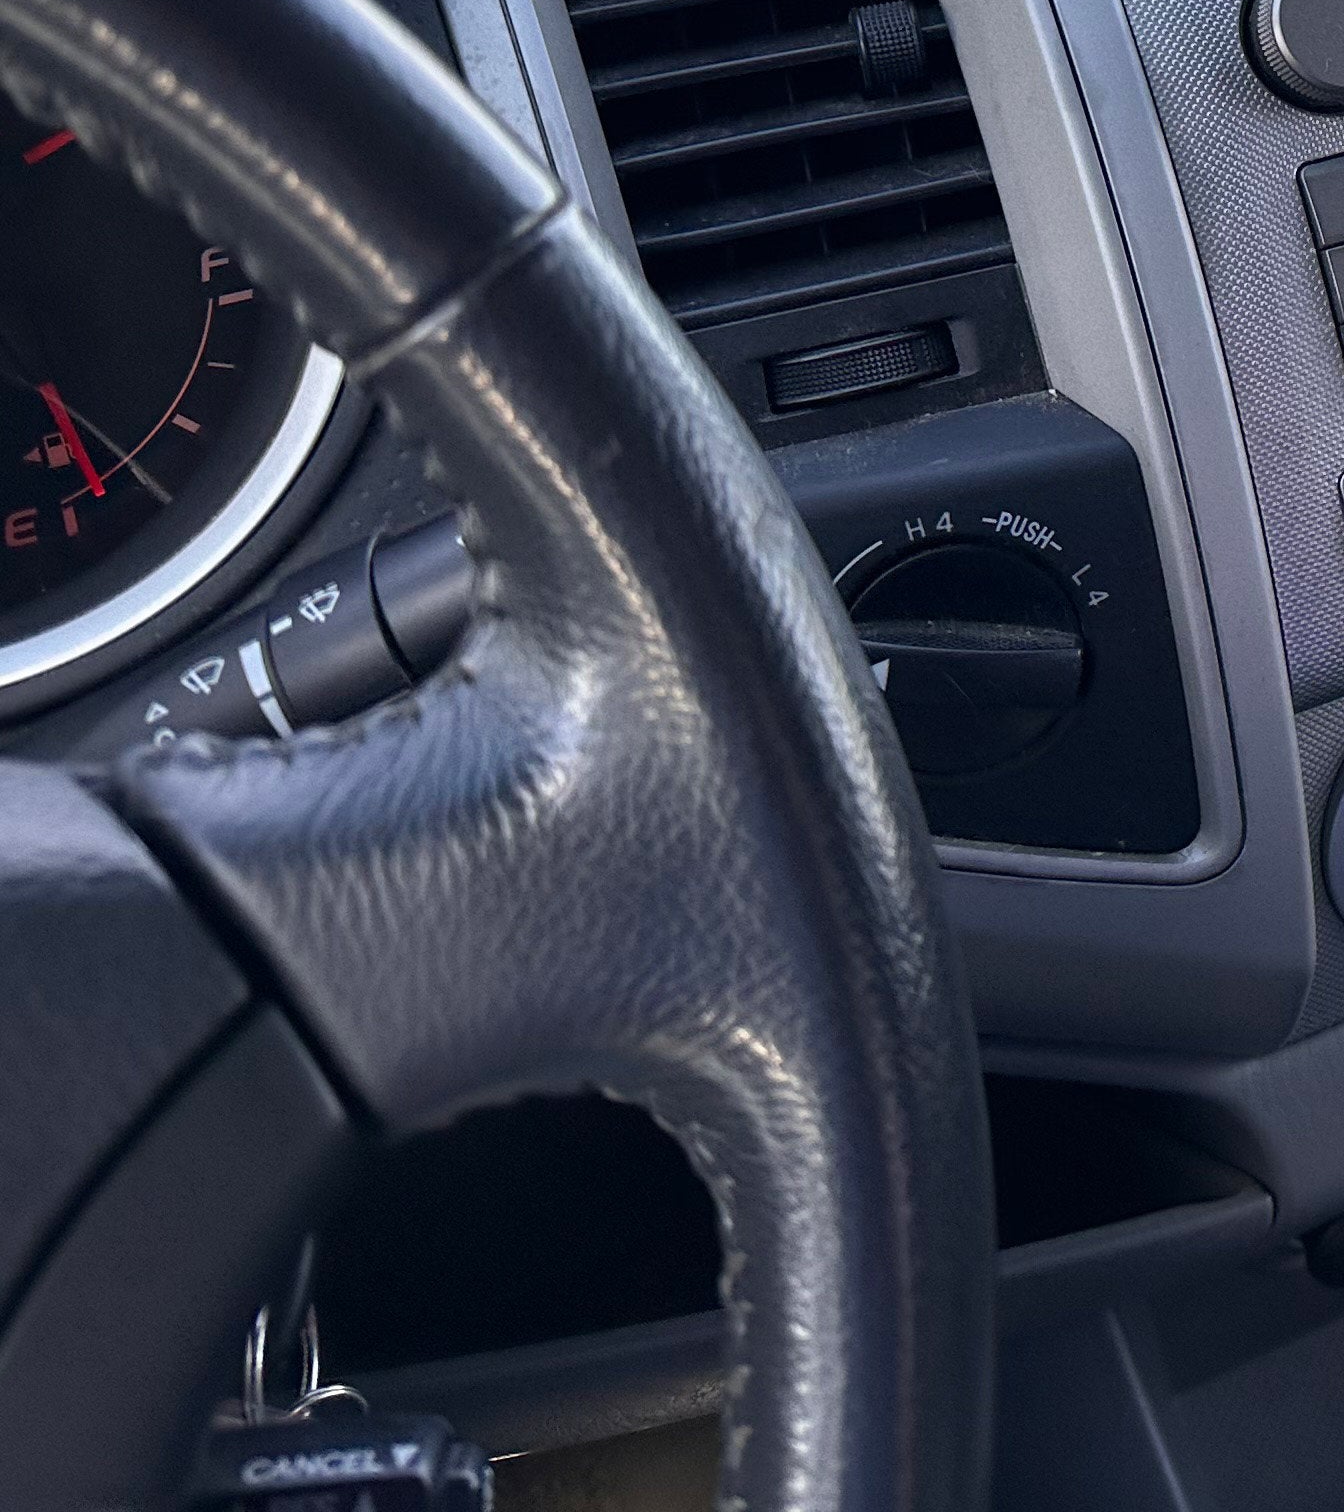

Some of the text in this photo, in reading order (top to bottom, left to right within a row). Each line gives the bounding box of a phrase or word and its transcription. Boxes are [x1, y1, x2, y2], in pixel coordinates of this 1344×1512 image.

[200, 246, 230, 282] F
[5, 508, 39, 547] E
[242, 1449, 381, 1486] CANCEL
